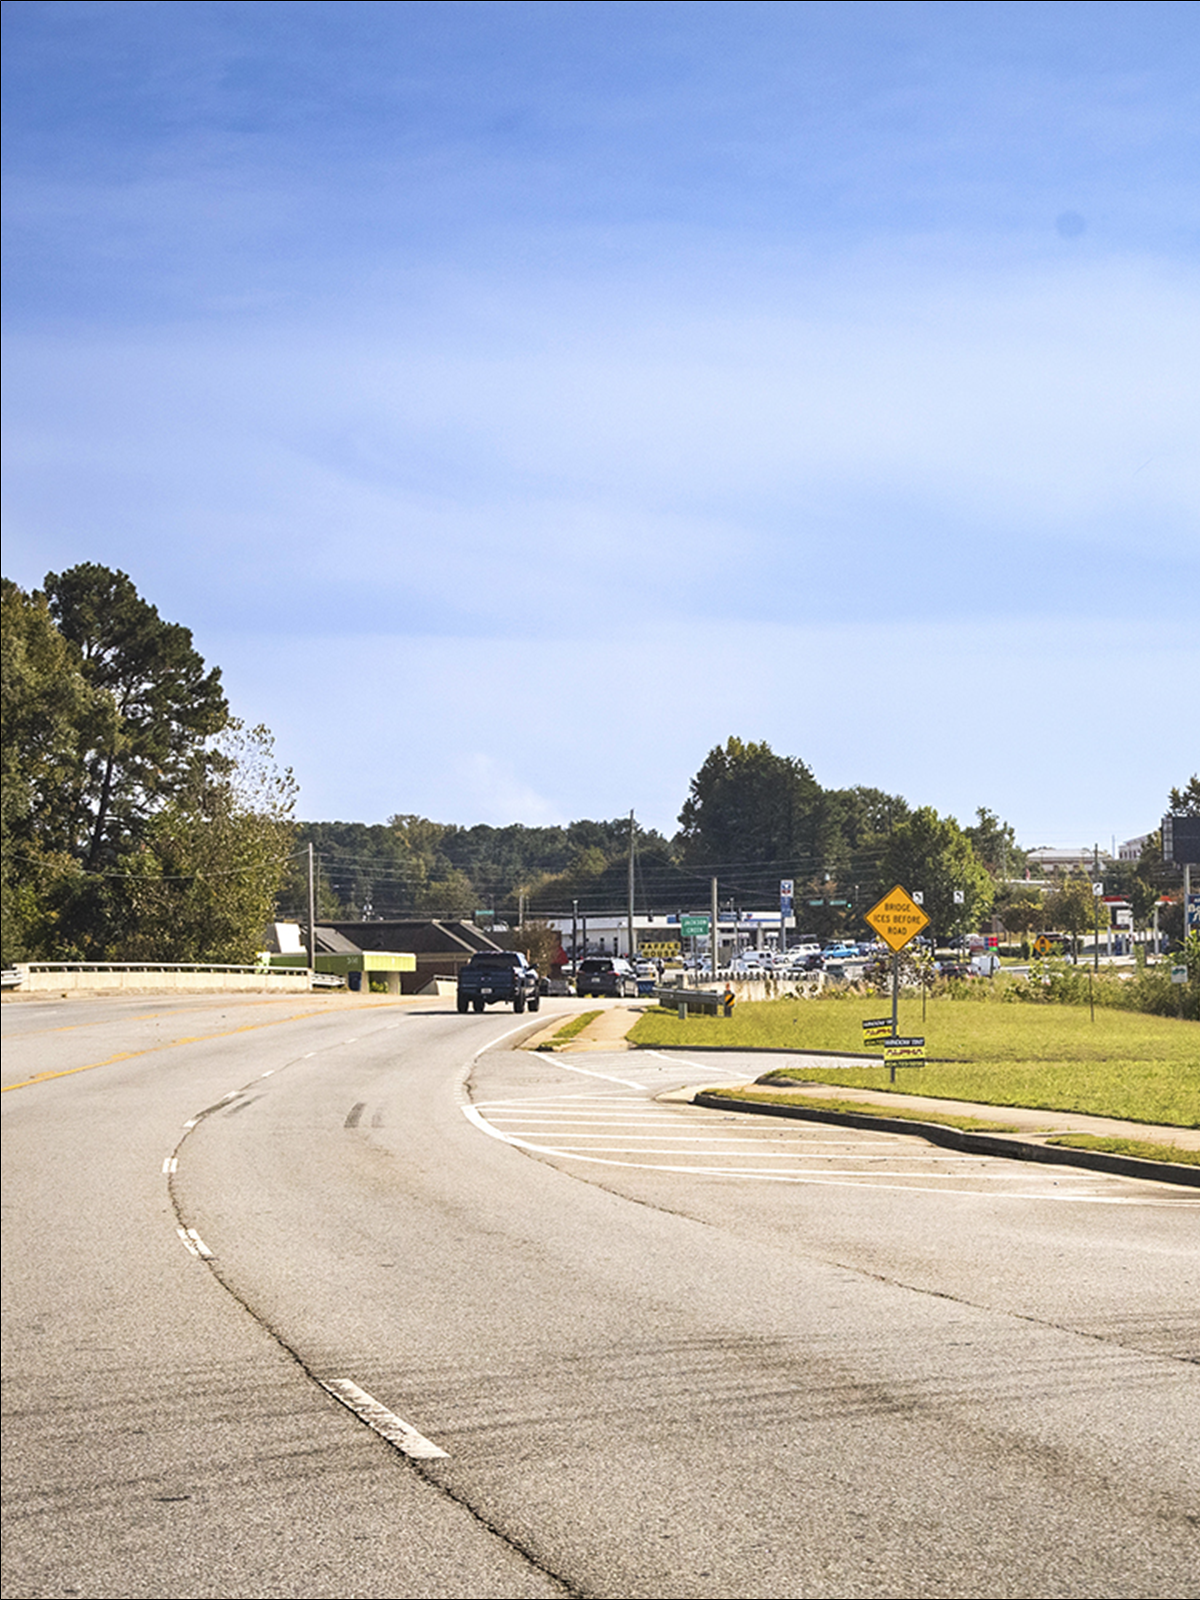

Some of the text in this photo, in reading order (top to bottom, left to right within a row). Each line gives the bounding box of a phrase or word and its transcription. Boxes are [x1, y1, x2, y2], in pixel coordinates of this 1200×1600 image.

[885, 903, 911, 912] BRIDGE
[873, 915, 921, 924] ICES BEFORE
[888, 926, 907, 935] ROAD
[640, 942, 680, 950] WAFFLE
[886, 1048, 923, 1056] ALPHA
